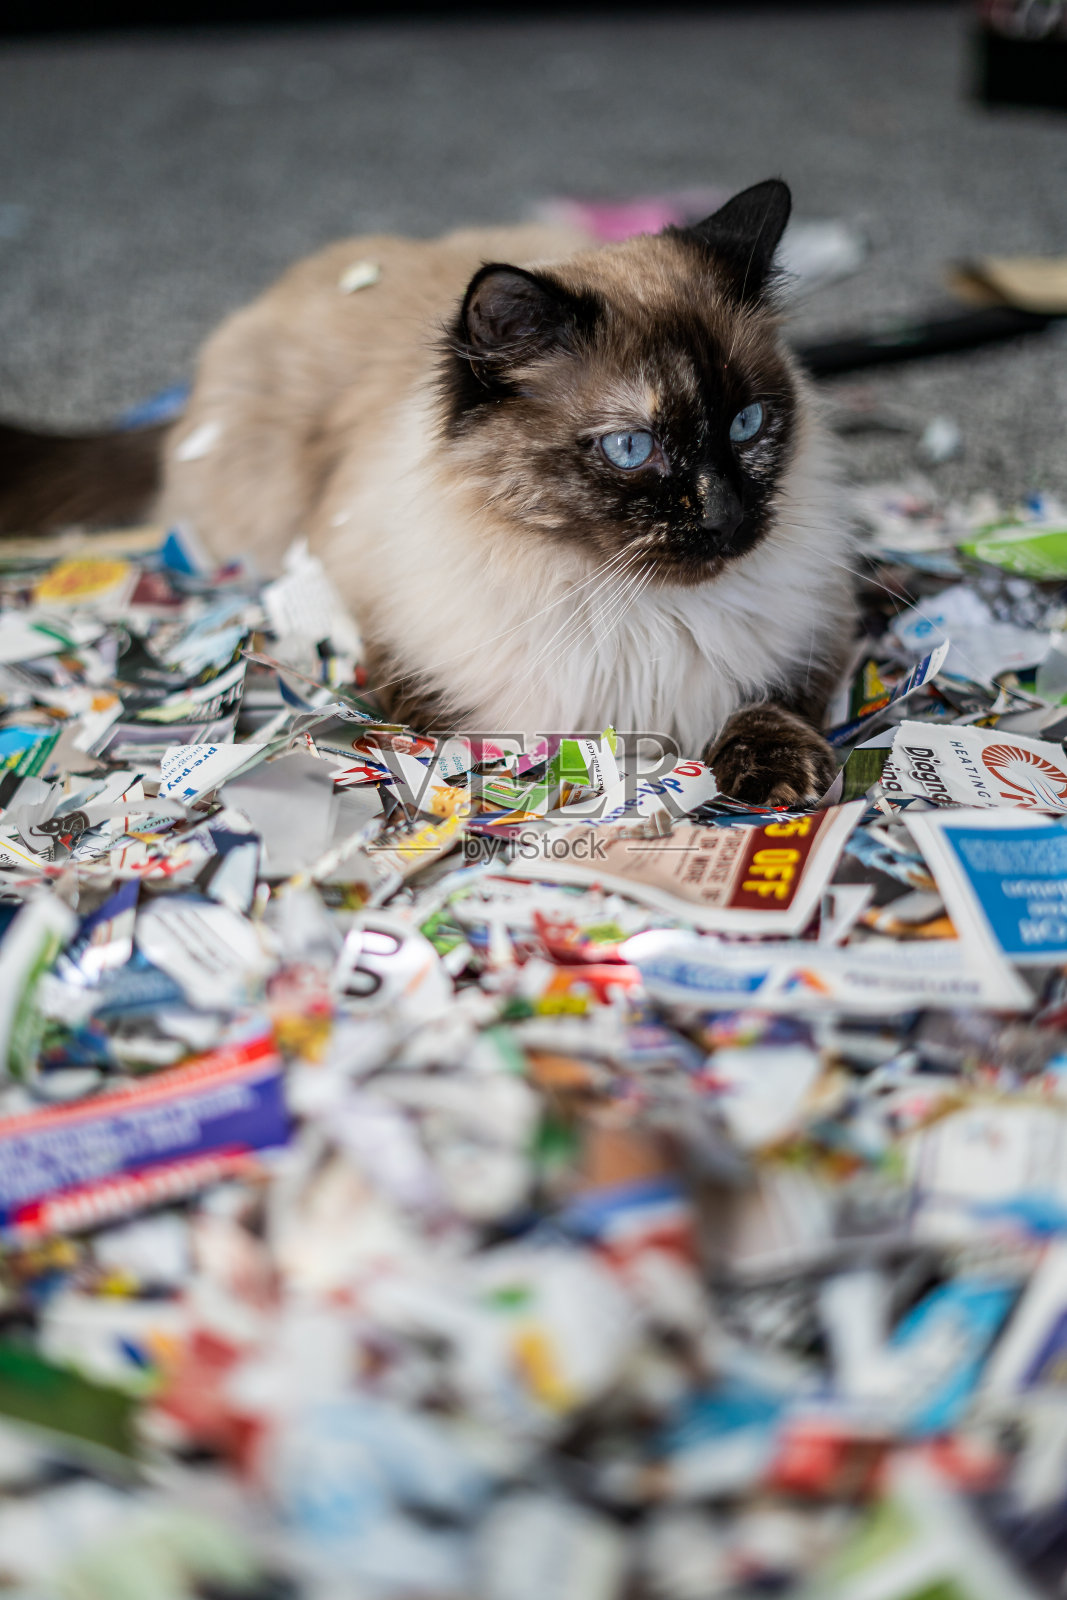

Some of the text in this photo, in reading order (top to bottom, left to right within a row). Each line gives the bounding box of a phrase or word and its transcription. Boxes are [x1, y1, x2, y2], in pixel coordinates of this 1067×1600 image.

[161, 745, 203, 781] program
[167, 747, 218, 791] pre-pay
[950, 741, 991, 798] HEATING
[742, 848, 799, 899] OFF
